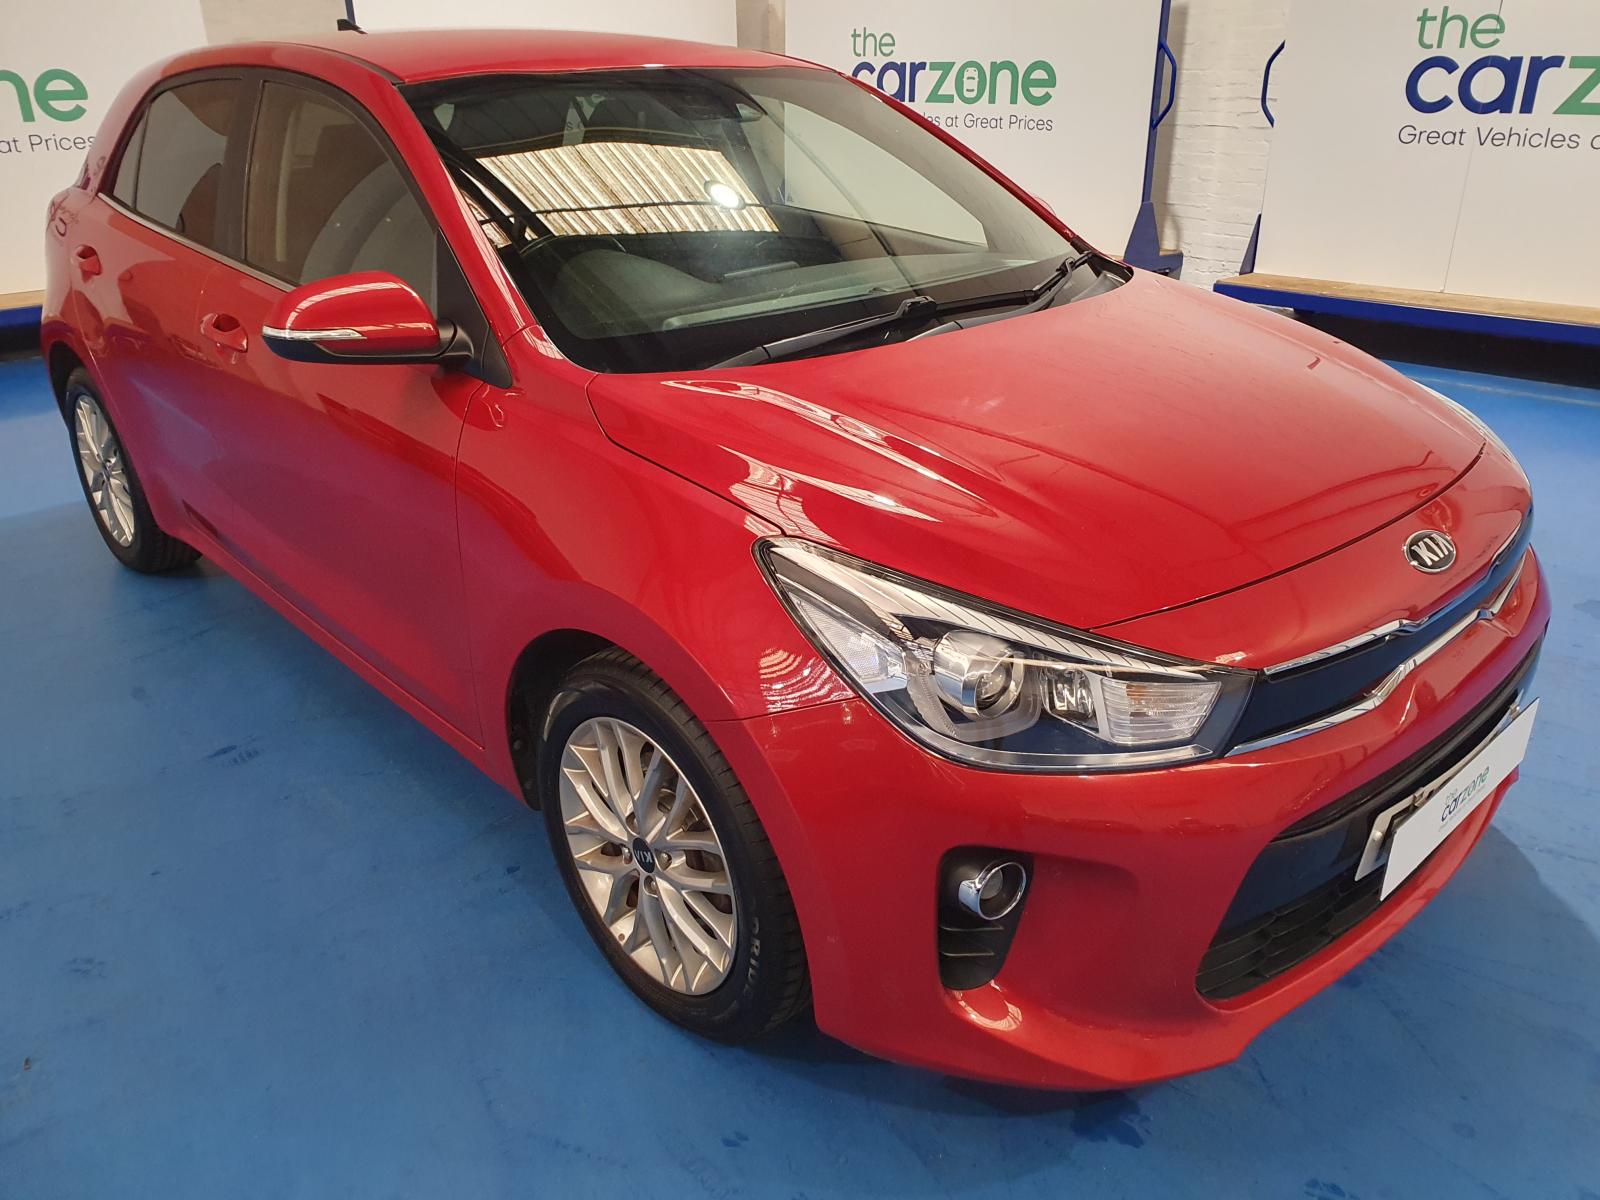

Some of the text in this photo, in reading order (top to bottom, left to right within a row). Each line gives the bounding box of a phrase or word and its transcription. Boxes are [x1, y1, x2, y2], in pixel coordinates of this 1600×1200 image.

[851, 27, 896, 57] the
[1416, 6, 1506, 49] the
[1405, 55, 1600, 115] carz
[945, 115, 958, 128] at
[963, 113, 1003, 130] Great
[1008, 114, 1053, 131] Prices
[1398, 124, 1466, 146] Great
[1476, 126, 1581, 149] Vehicles
[1411, 533, 1454, 566] KIA
[1441, 766, 1490, 822] carzone
